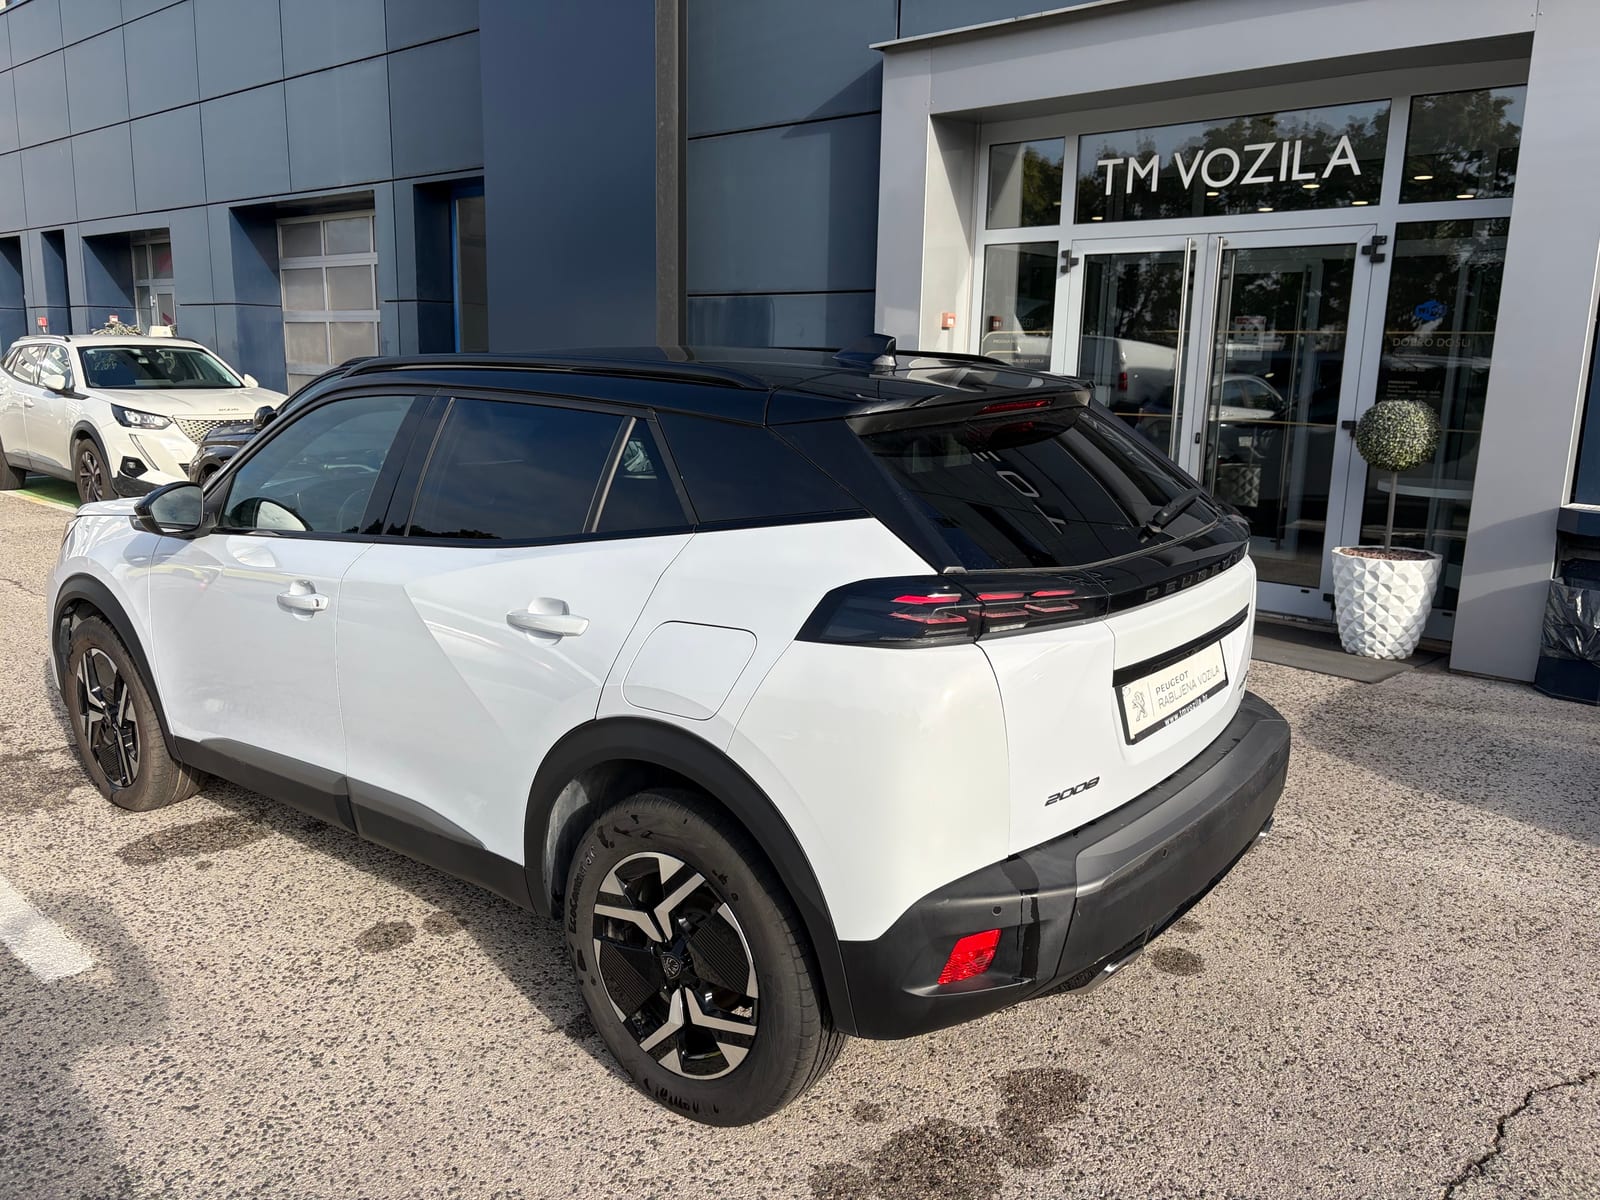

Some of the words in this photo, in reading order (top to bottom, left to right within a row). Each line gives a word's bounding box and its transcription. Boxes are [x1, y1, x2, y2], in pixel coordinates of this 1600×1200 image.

[1097, 154, 1160, 197] TM
[1174, 135, 1362, 191] VOZILA
[1155, 670, 1189, 695] PEUGEOT
[1158, 681, 1198, 709] RABLJENA
[1199, 665, 1220, 686] VOZILA
[1044, 776, 1100, 807] 2008
